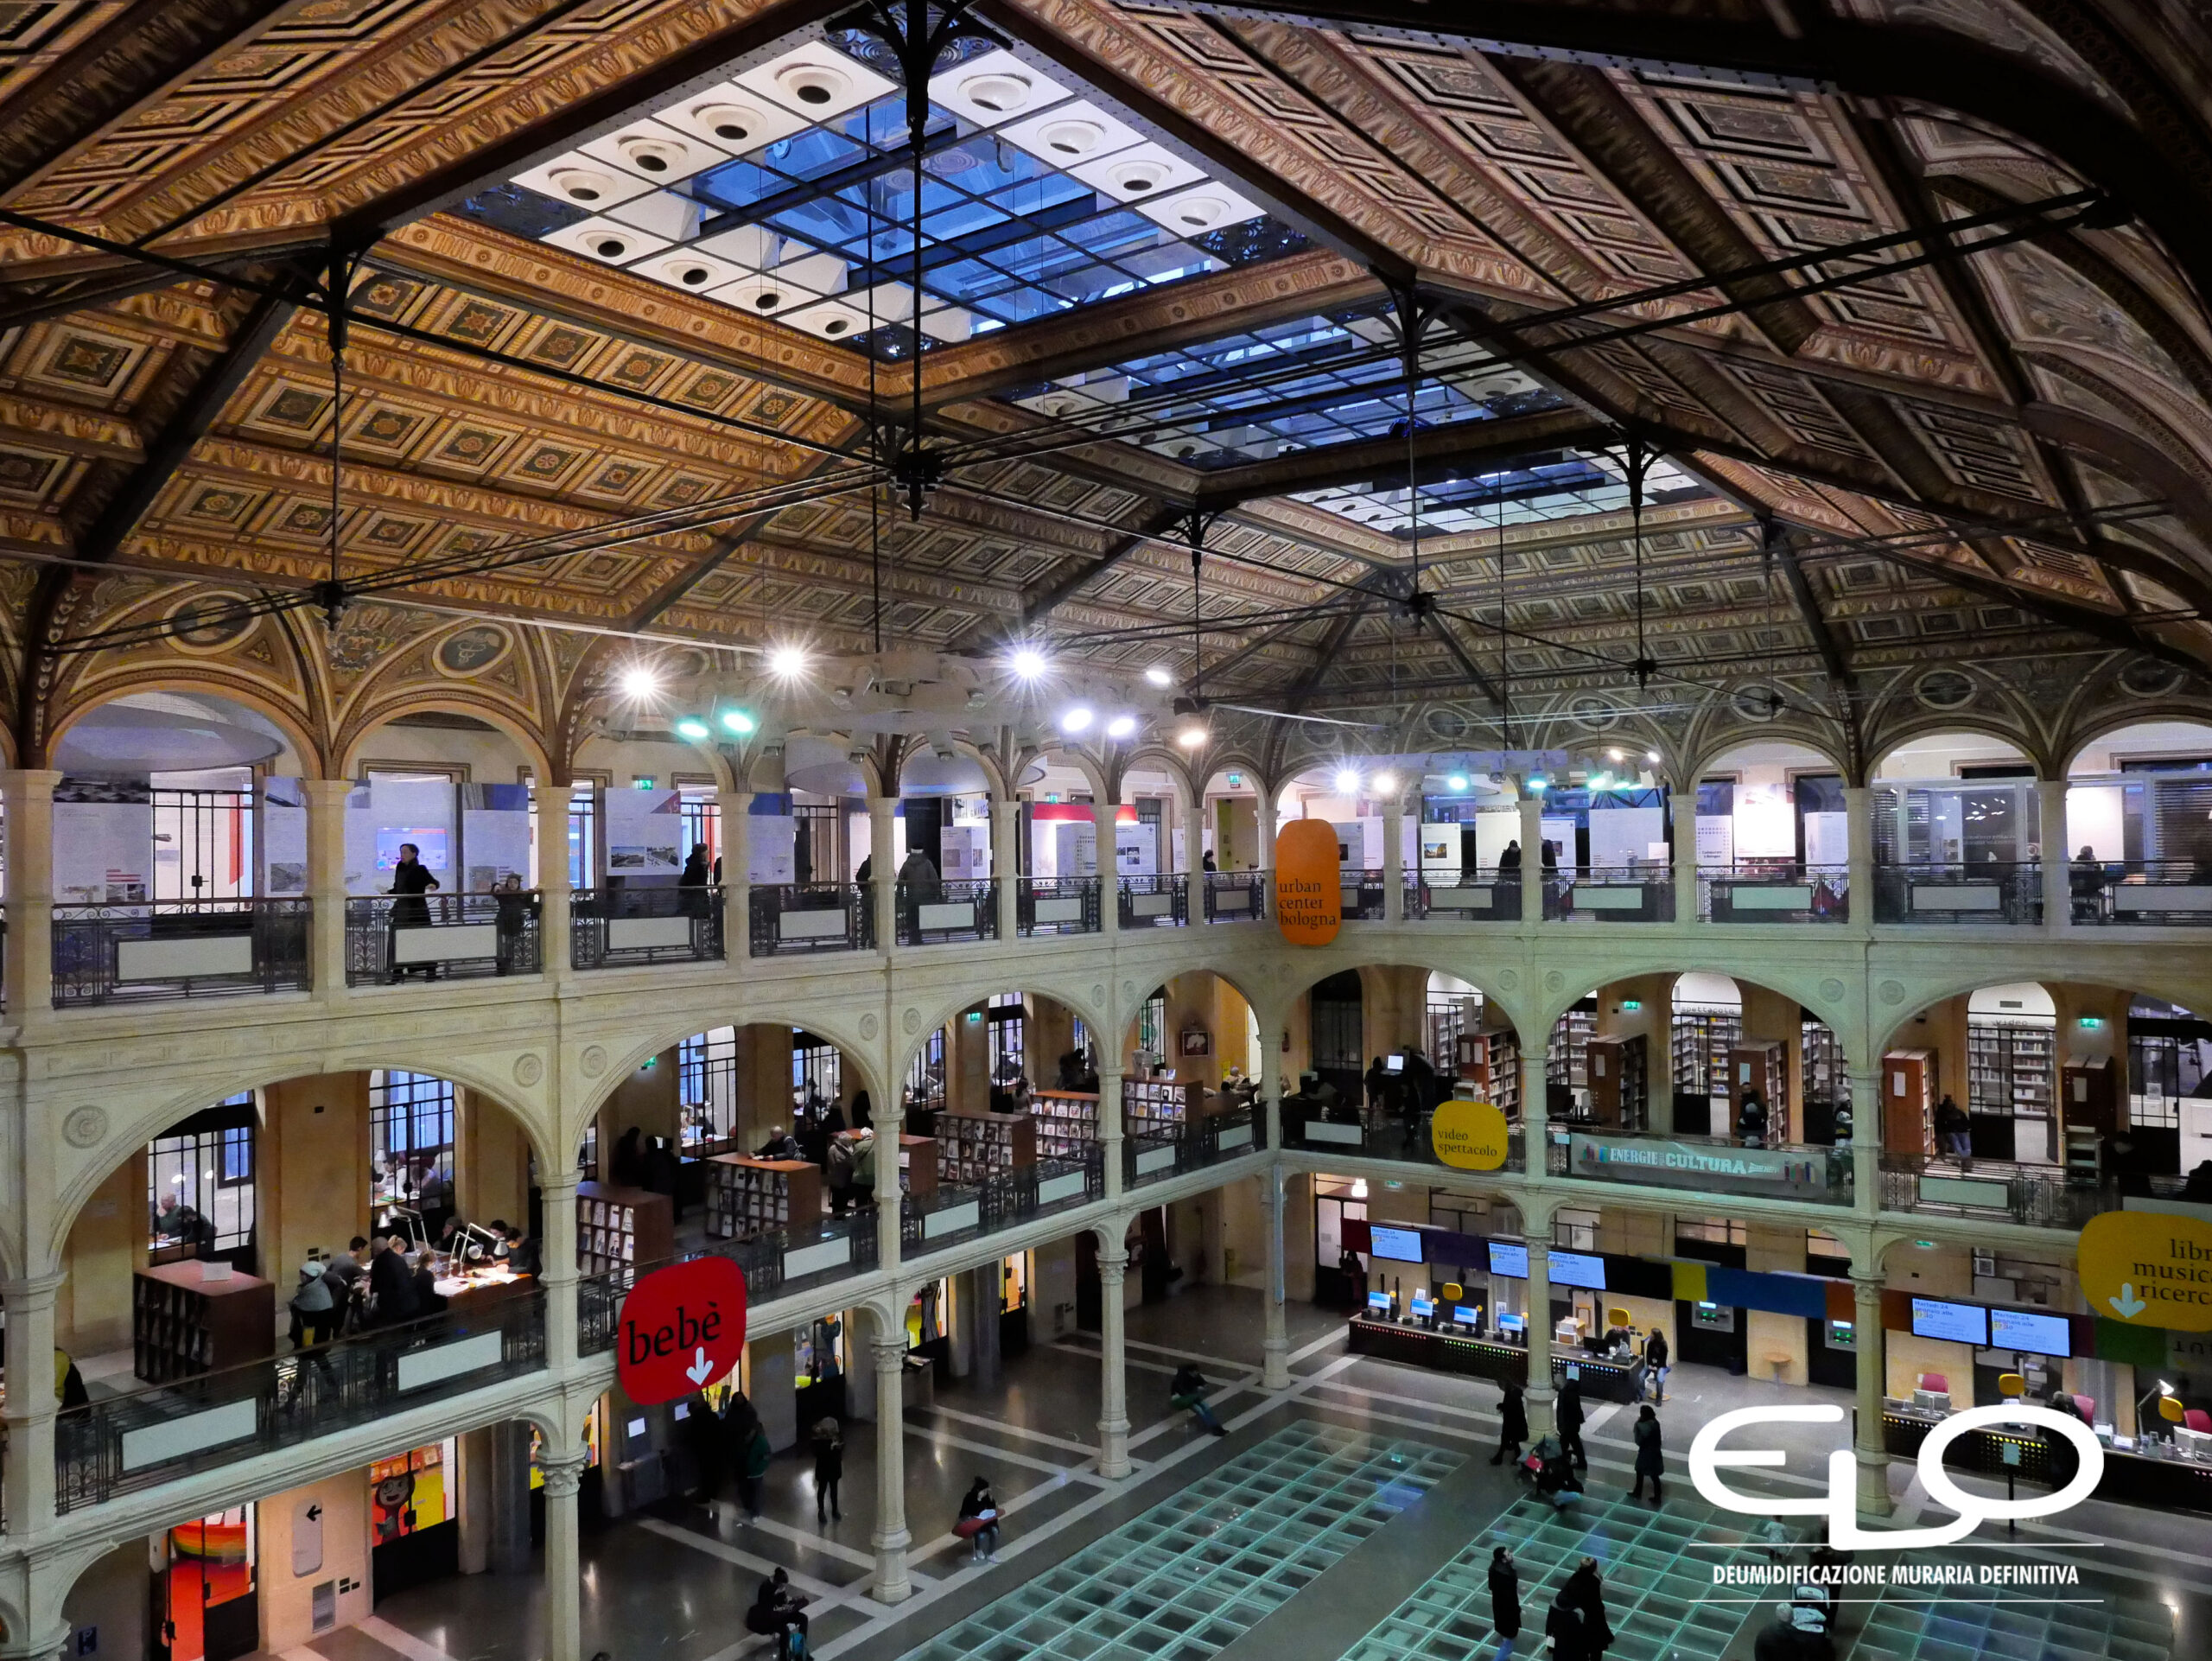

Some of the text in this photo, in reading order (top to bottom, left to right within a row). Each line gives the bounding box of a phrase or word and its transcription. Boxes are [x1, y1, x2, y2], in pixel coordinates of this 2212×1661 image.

[1279, 878, 1321, 893] urban
[1279, 898, 1324, 910] center
[1280, 911, 1336, 931] bologna
[1681, 1006, 1734, 1015] spettacolo
[1438, 1129, 1469, 1141] video
[1438, 1143, 1497, 1157] spettacolo
[1610, 1148, 1658, 1166] ENERGIE
[1665, 1152, 1747, 1175] CULTURA
[2170, 1238, 2212, 1262] libr
[2133, 1262, 2212, 1283] music
[626, 1301, 721, 1365] bebè
